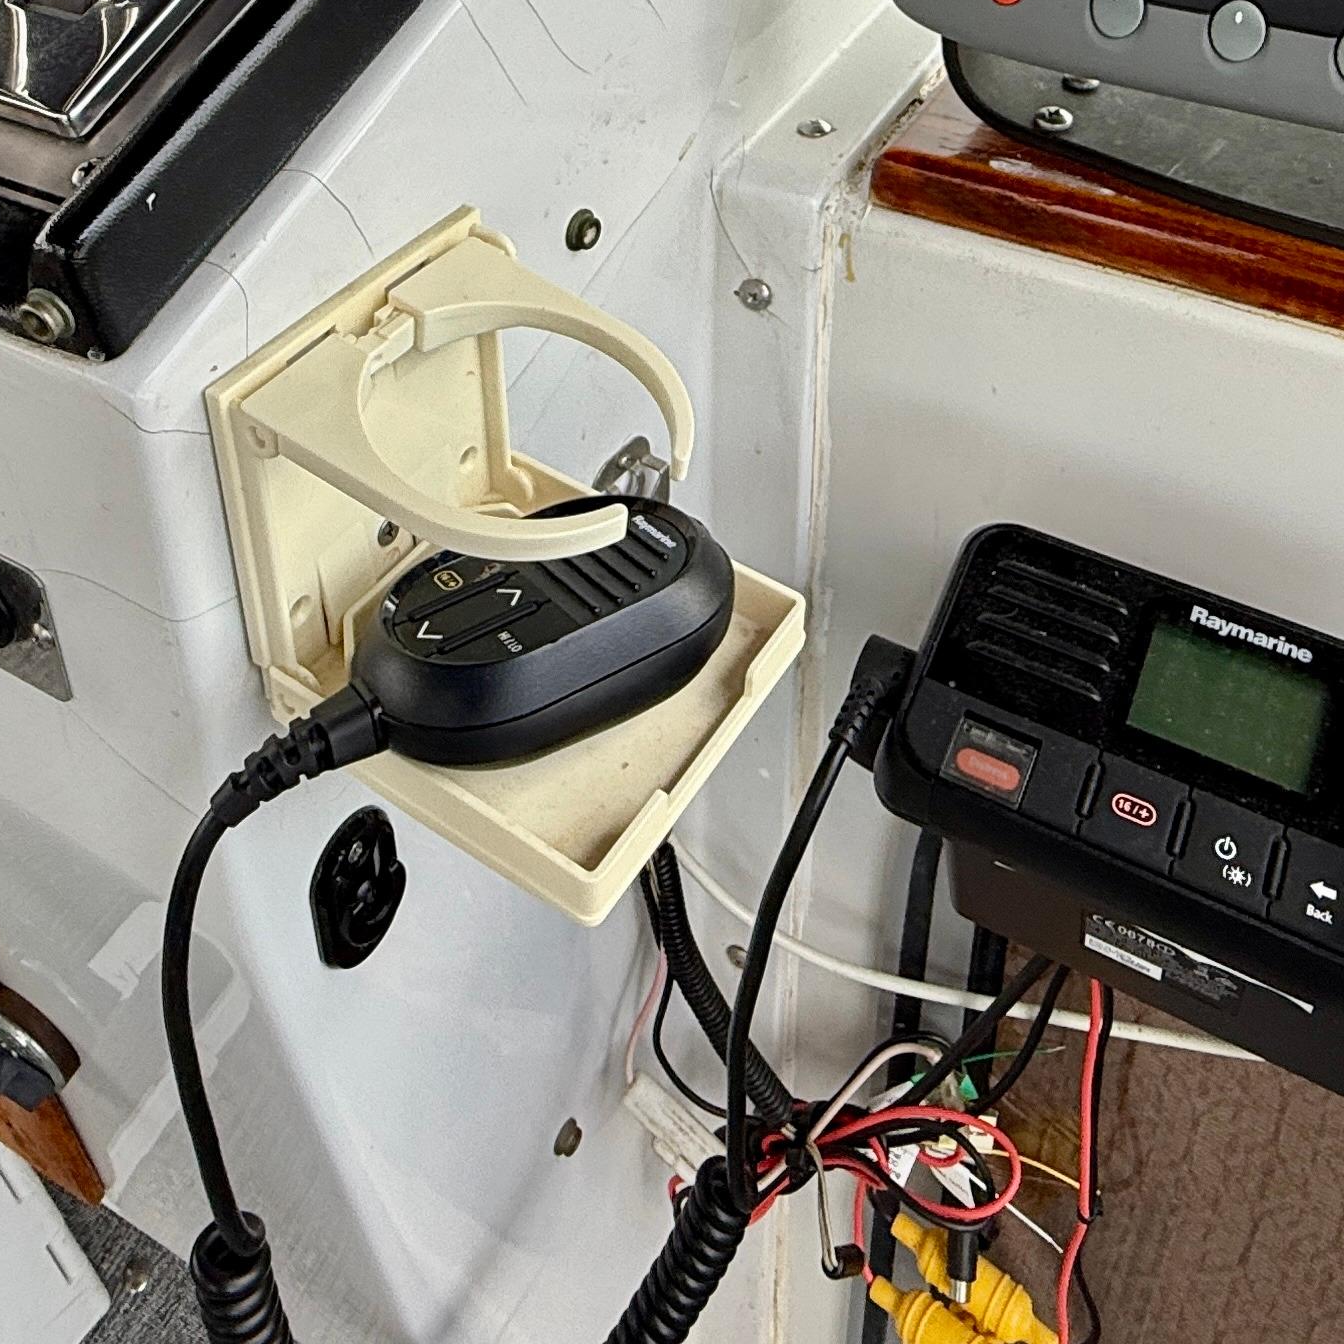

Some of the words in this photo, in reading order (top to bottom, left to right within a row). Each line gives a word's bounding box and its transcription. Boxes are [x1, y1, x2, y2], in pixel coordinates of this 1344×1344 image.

[631, 515, 677, 548] Raymarine
[1189, 604, 1313, 664] Raymarine
[1306, 903, 1333, 925] Back
